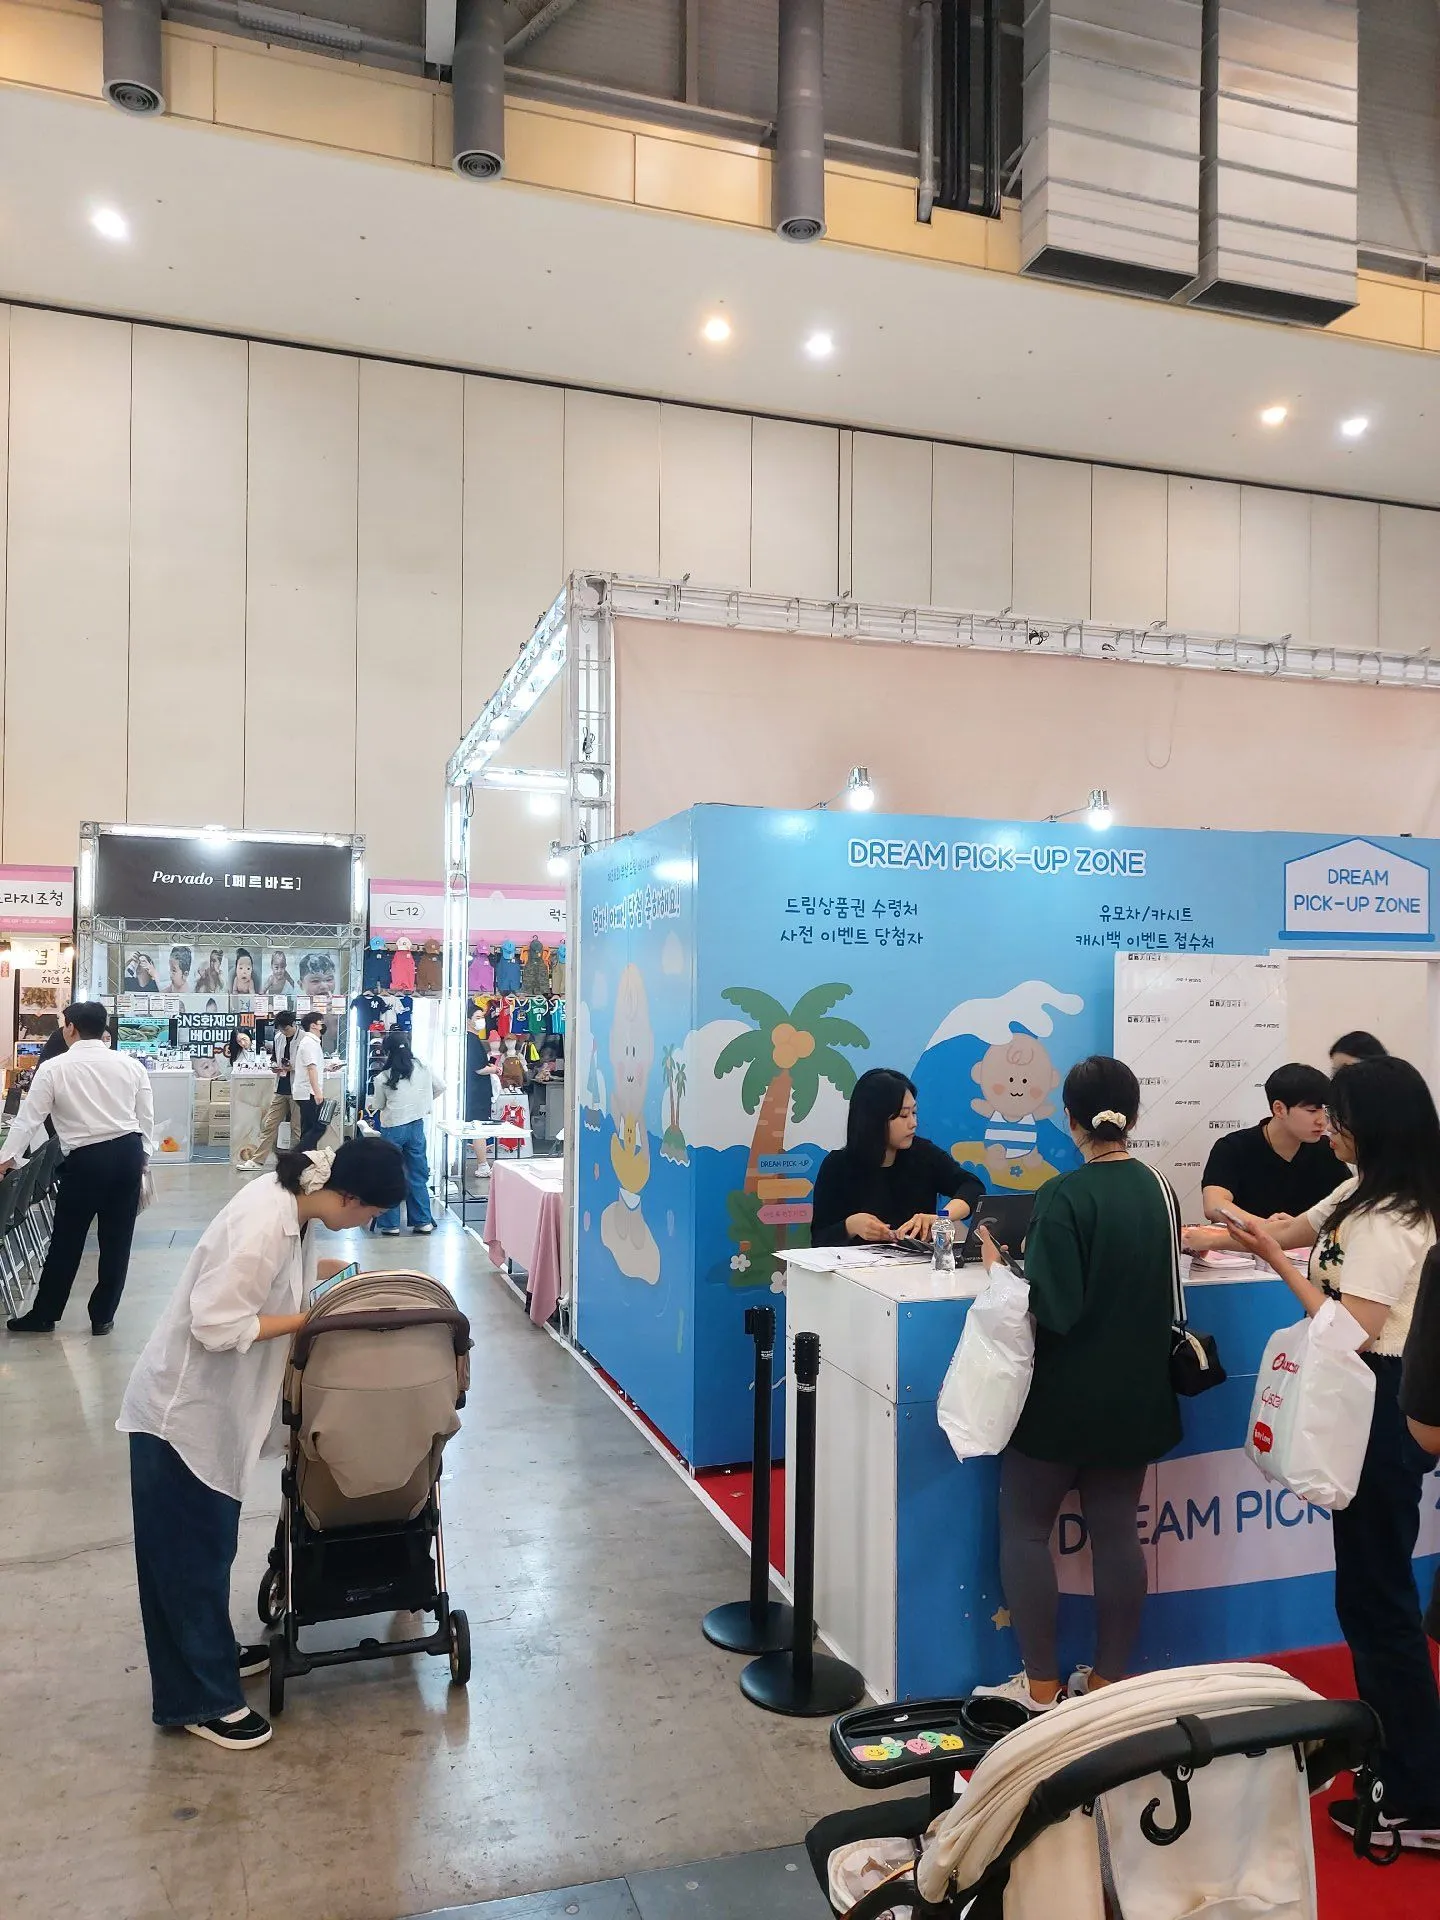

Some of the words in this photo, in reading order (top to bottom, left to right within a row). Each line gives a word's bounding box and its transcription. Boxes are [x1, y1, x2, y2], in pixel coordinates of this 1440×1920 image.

[849, 841, 945, 867] DREAM
[955, 845, 1068, 871] PICK-UP
[1075, 849, 1144, 874] ZONE
[152, 870, 214, 886] Pervado
[1328, 868, 1388, 886] DREAM
[0, 890, 63, 907] 라지조청
[785, 897, 865, 919] 드림상품권
[872, 899, 917, 919] 수령처
[1294, 894, 1370, 912] PICK-UP
[1375, 896, 1421, 913] ZONE
[389, 906, 419, 916] L-12
[1100, 905, 1193, 922] 유모차/카시트
[780, 926, 813, 944] 사전
[821, 926, 869, 945] 이벤트
[875, 926, 924, 947] 당첨자
[1075, 930, 1121, 949] 캐시백
[1127, 932, 1169, 949] 이벤트
[1174, 932, 1214, 951] 접수처
[1059, 1496, 1220, 1555] DEAM
